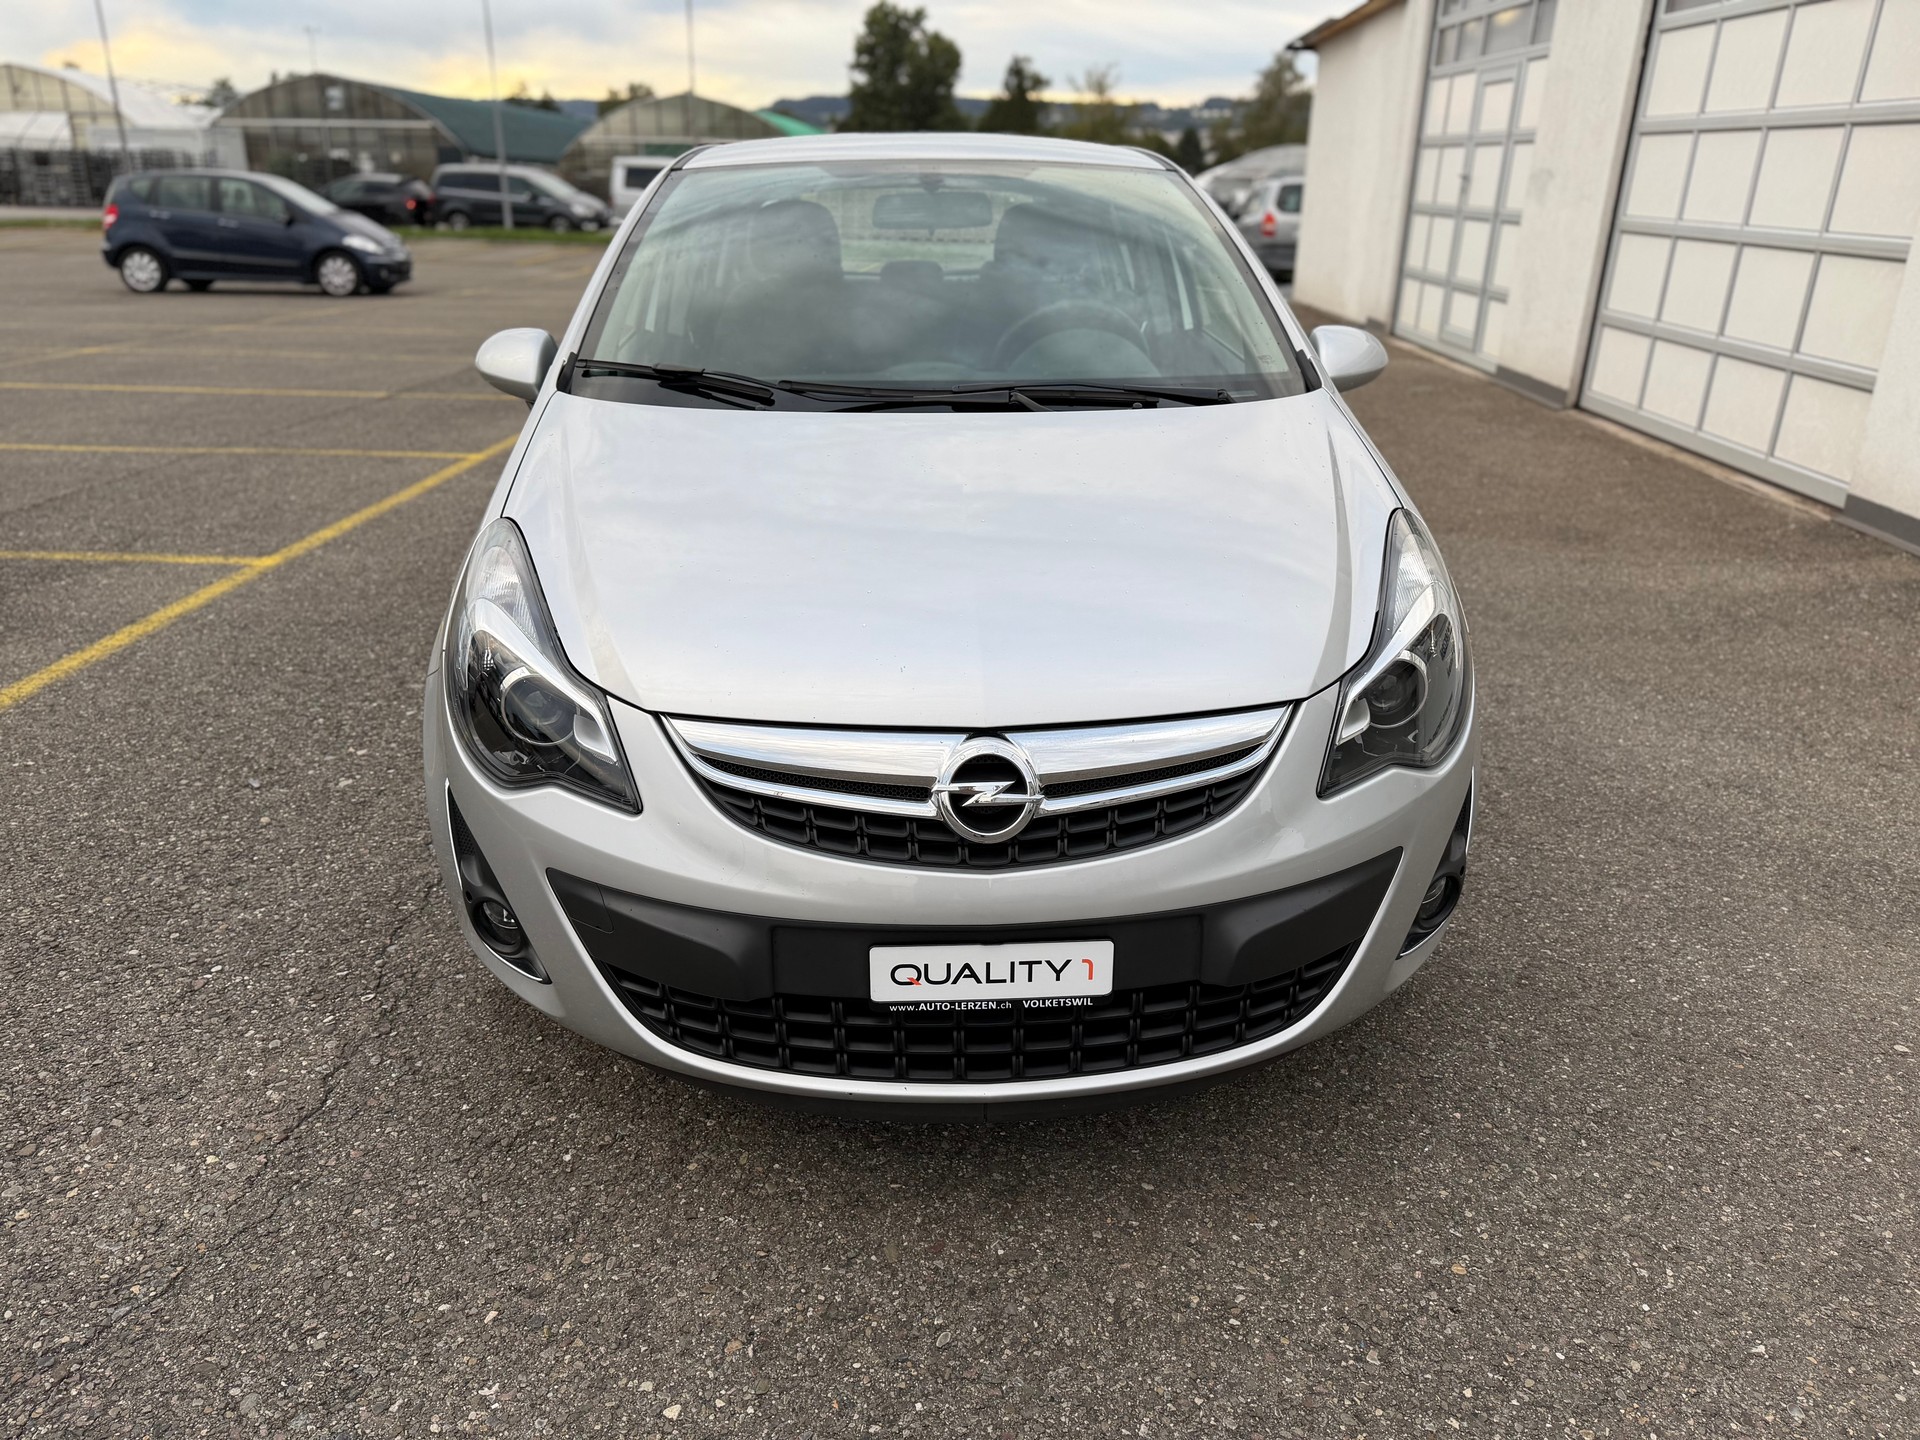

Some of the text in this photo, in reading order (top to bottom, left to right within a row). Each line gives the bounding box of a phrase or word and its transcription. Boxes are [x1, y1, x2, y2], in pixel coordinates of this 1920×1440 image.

[890, 958, 1094, 986] QUALITY 1
[889, 997, 1093, 1012] www.AUTO-LERZEN.ch VOLKETSWIL
